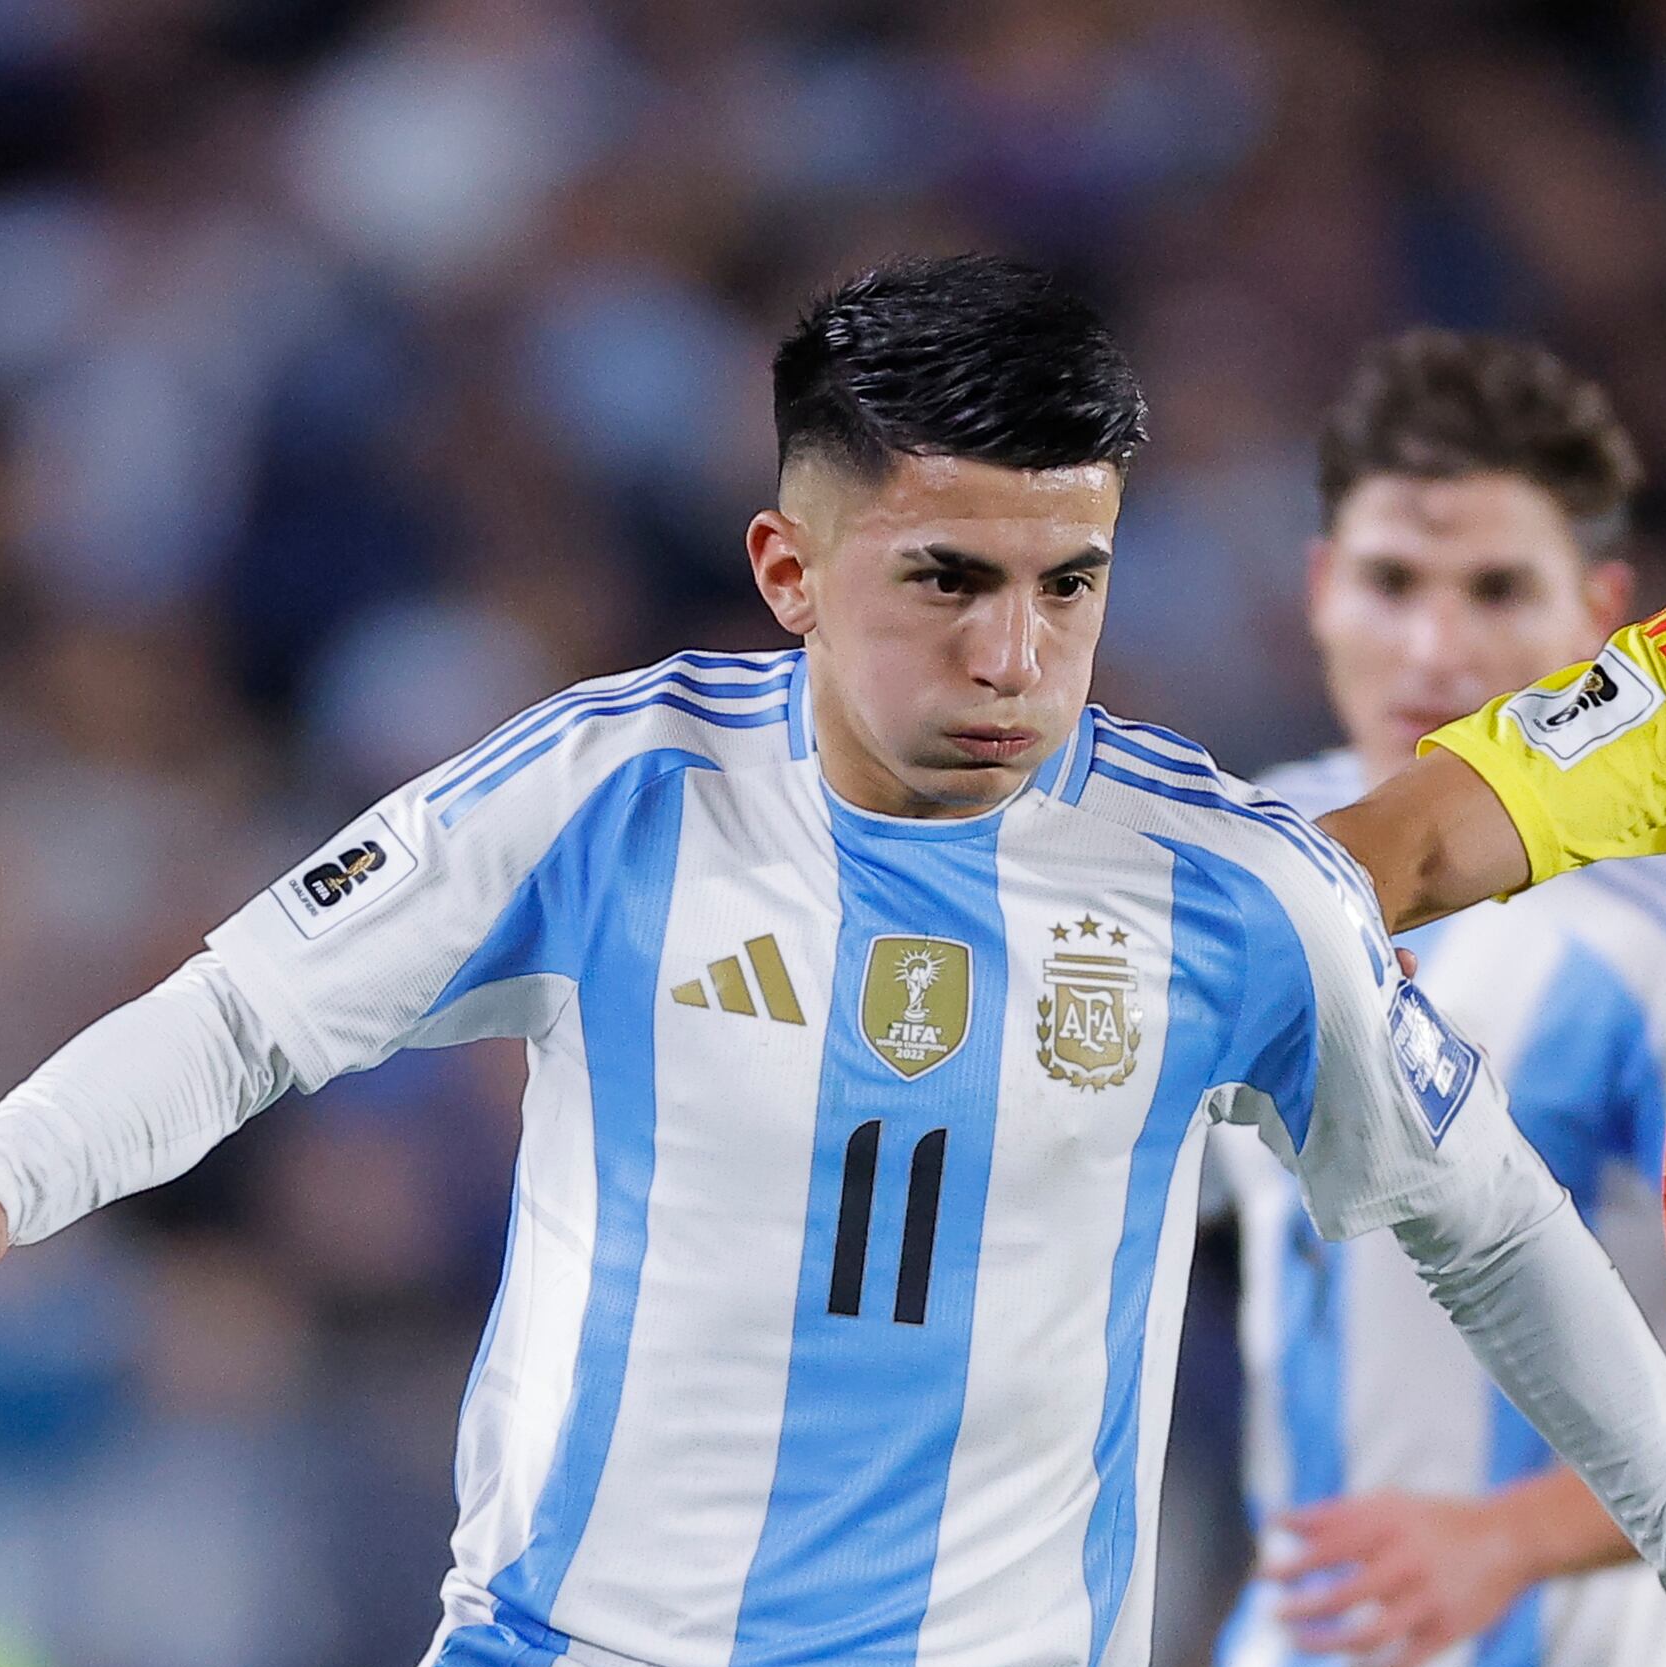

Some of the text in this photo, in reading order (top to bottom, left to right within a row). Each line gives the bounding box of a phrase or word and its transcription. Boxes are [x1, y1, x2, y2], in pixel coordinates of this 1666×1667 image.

[1059, 986, 1122, 1053] AFA
[895, 1048, 925, 1060] 2022
[826, 1119, 948, 1326] 11
